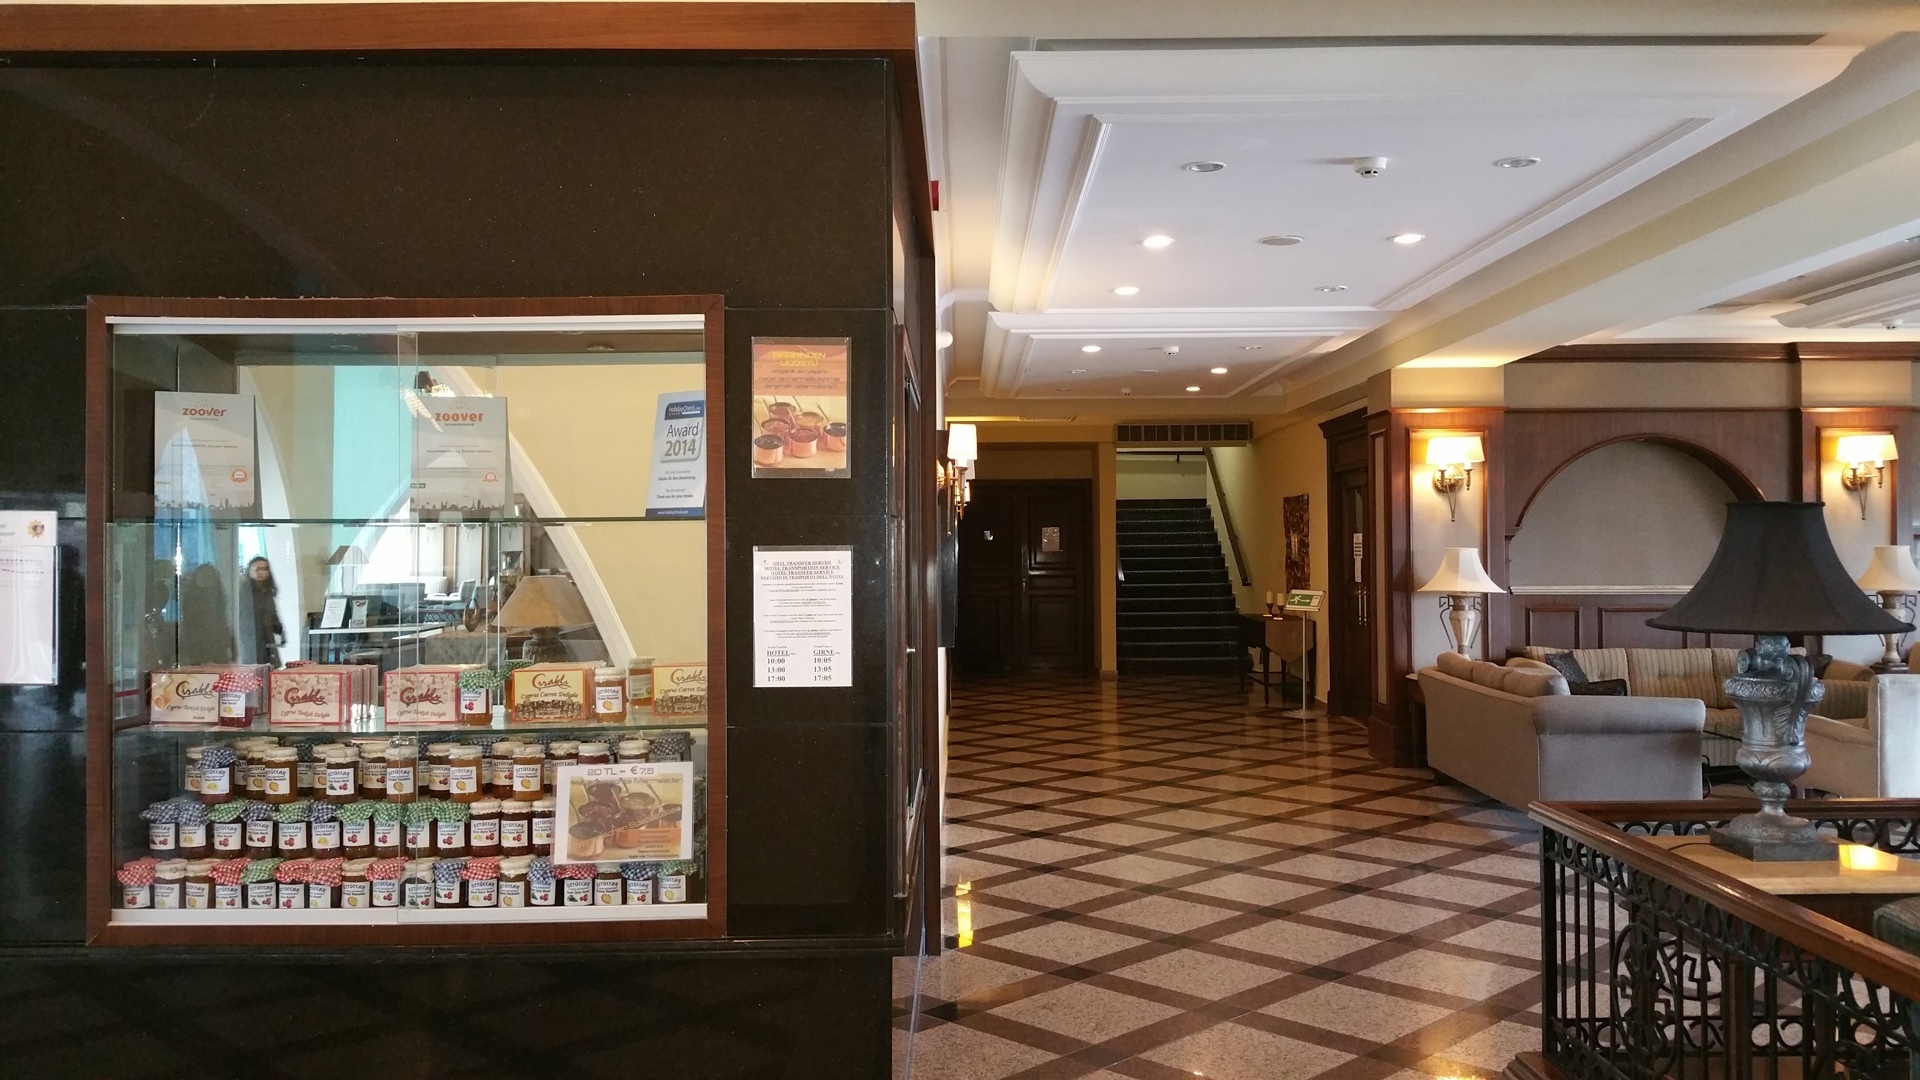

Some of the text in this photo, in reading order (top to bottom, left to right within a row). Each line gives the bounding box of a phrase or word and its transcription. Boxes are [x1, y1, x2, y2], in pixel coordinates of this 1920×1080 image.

[182, 407, 227, 417] zoover
[434, 413, 484, 422] zoover
[667, 422, 699, 437] Award
[665, 439, 696, 456] 2014
[587, 768, 602, 776] 20
[604, 767, 617, 776] TL
[630, 766, 638, 775] €
[640, 767, 654, 775] 7,5
